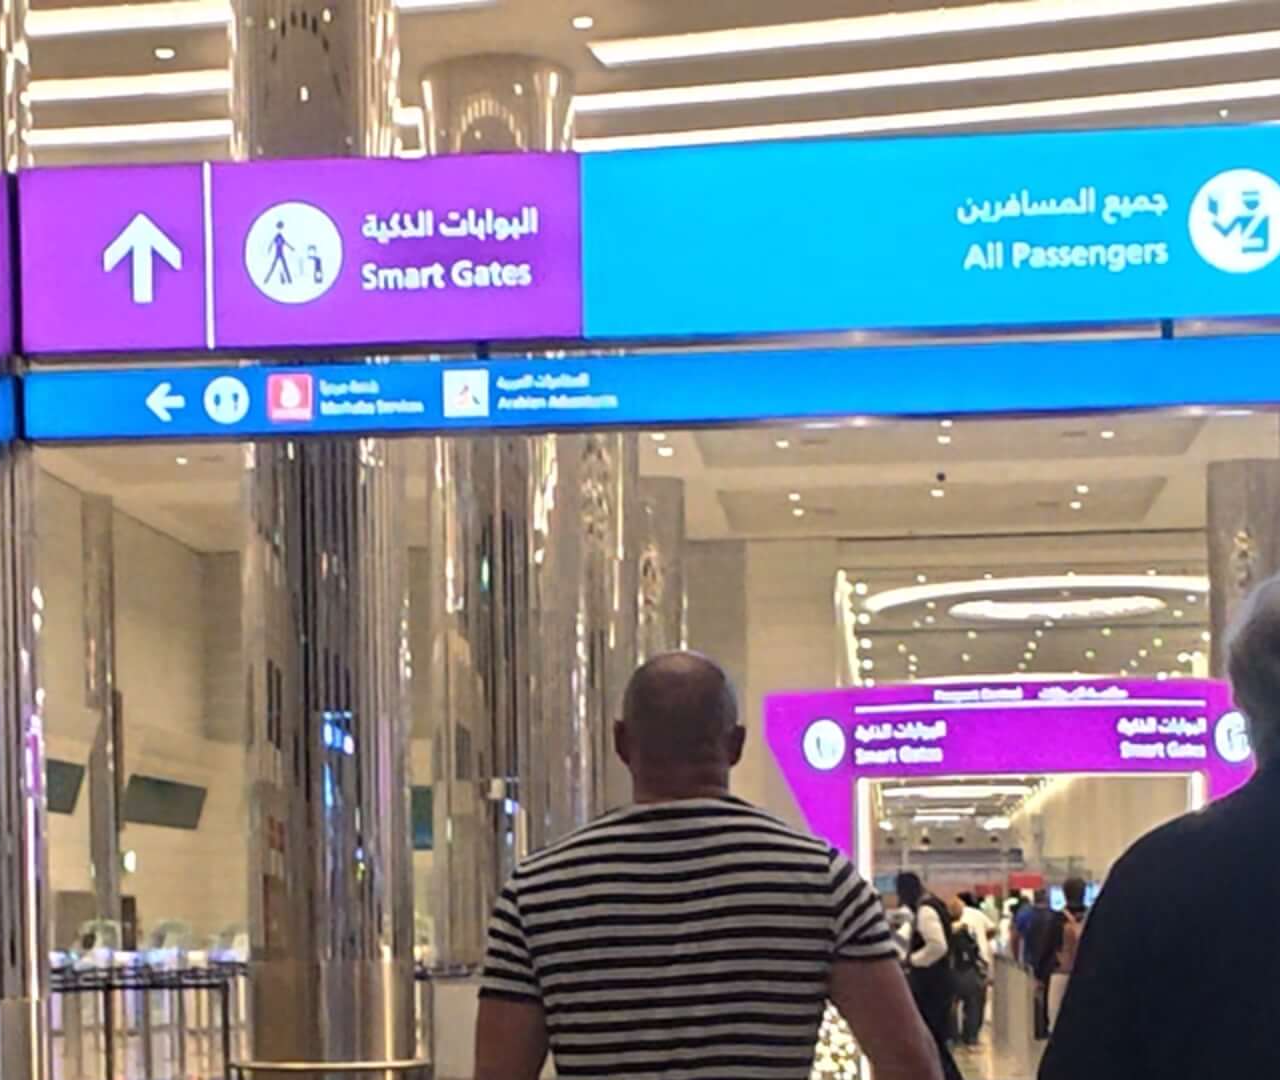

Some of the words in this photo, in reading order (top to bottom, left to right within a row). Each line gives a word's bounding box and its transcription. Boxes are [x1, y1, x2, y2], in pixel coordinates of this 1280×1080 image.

[956, 187, 1097, 225] المسافرين
[1101, 192, 1170, 225] جميع
[361, 209, 434, 242] الذكية
[439, 208, 538, 240] البوابات
[963, 241, 1004, 270] All
[1011, 241, 1169, 273] Passengers
[361, 263, 445, 290] Smart
[450, 259, 532, 288] Gates
